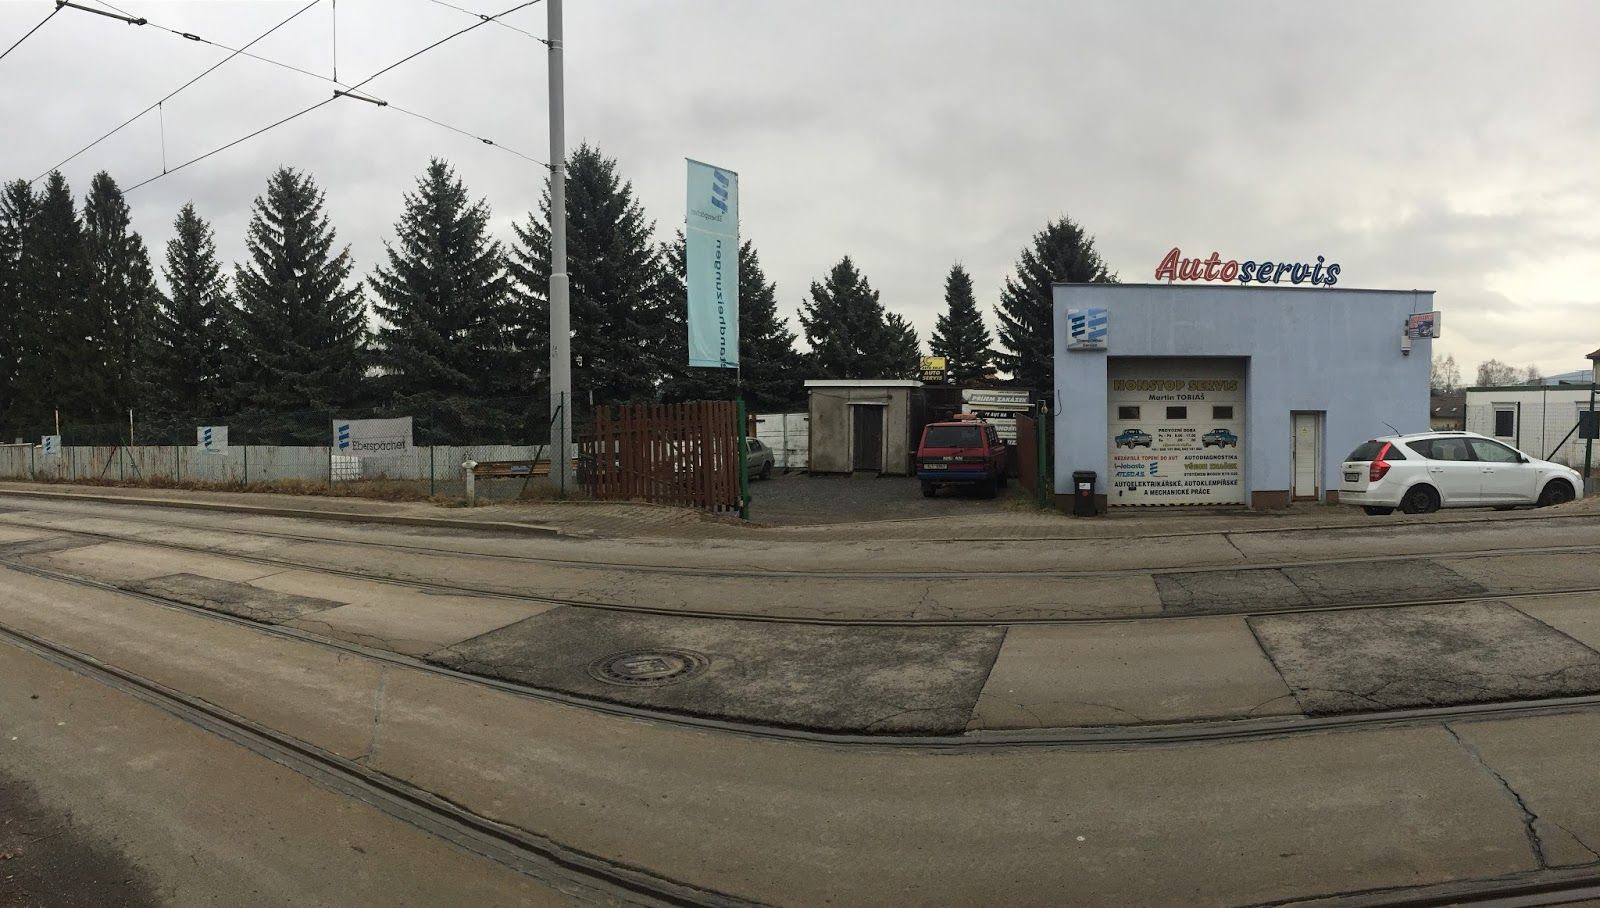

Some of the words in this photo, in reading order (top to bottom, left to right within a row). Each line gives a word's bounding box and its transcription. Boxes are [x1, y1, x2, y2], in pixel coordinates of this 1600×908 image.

[1155, 247, 1341, 286] Autoservis
[1113, 379, 1185, 391] NONSTOP
[1187, 379, 1238, 391] SERVIS
[1150, 488, 1190, 496] MECHANICKÉ
[1190, 487, 1211, 495] PRÁCE
